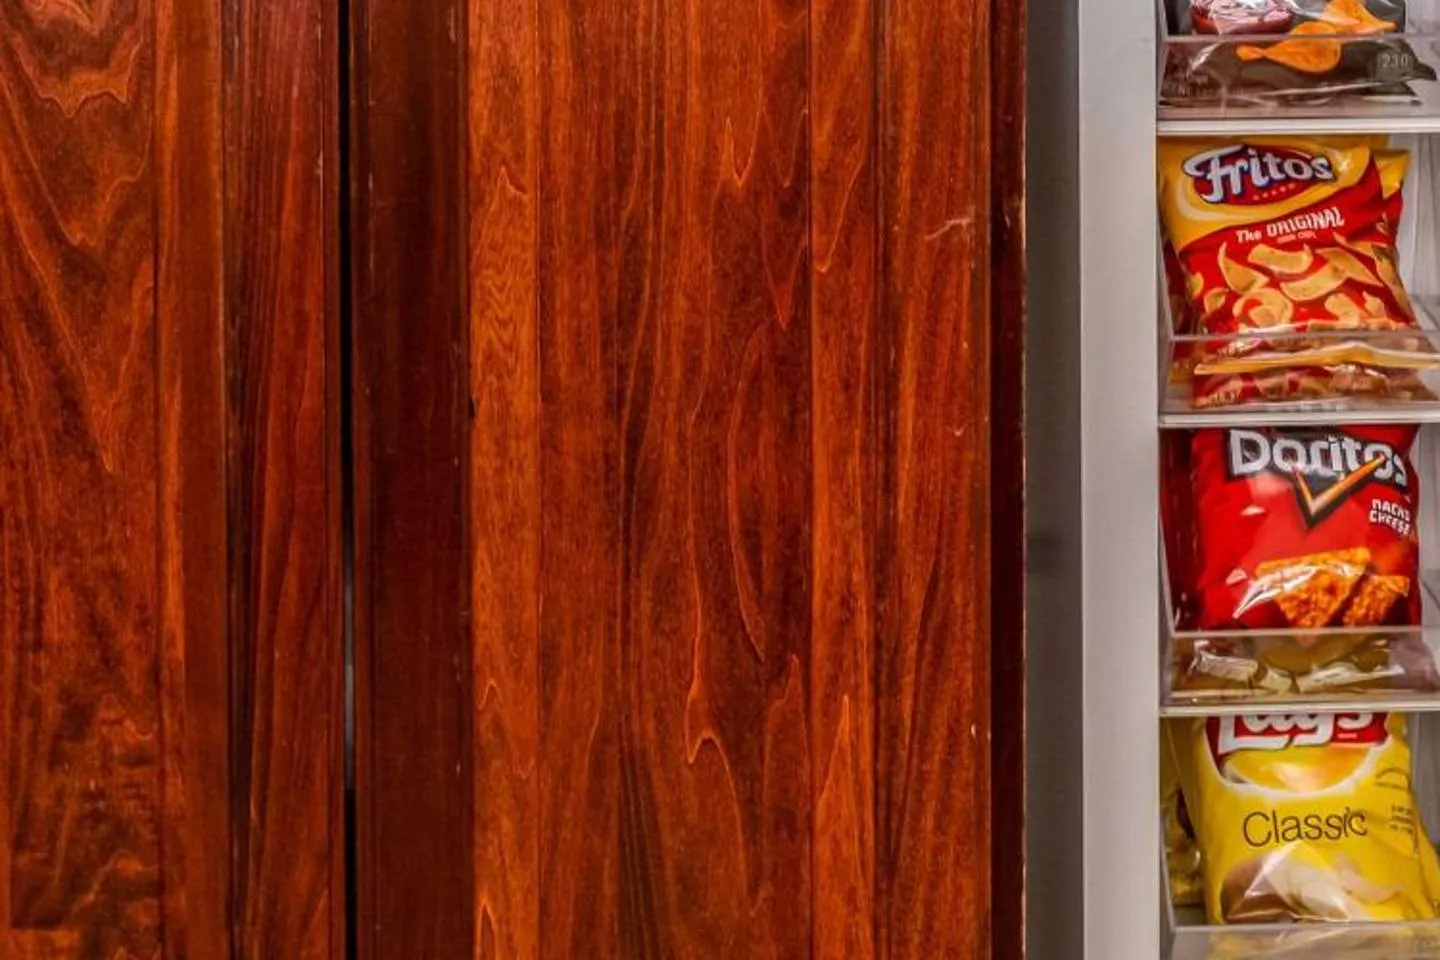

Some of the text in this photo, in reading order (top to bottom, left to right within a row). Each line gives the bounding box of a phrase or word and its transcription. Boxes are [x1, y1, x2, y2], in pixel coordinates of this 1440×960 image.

[1183, 144, 1337, 203] Fritos
[1266, 206, 1345, 237] ORIGINAL
[1229, 428, 1407, 487] Doritos
[1242, 806, 1369, 848] Classic
